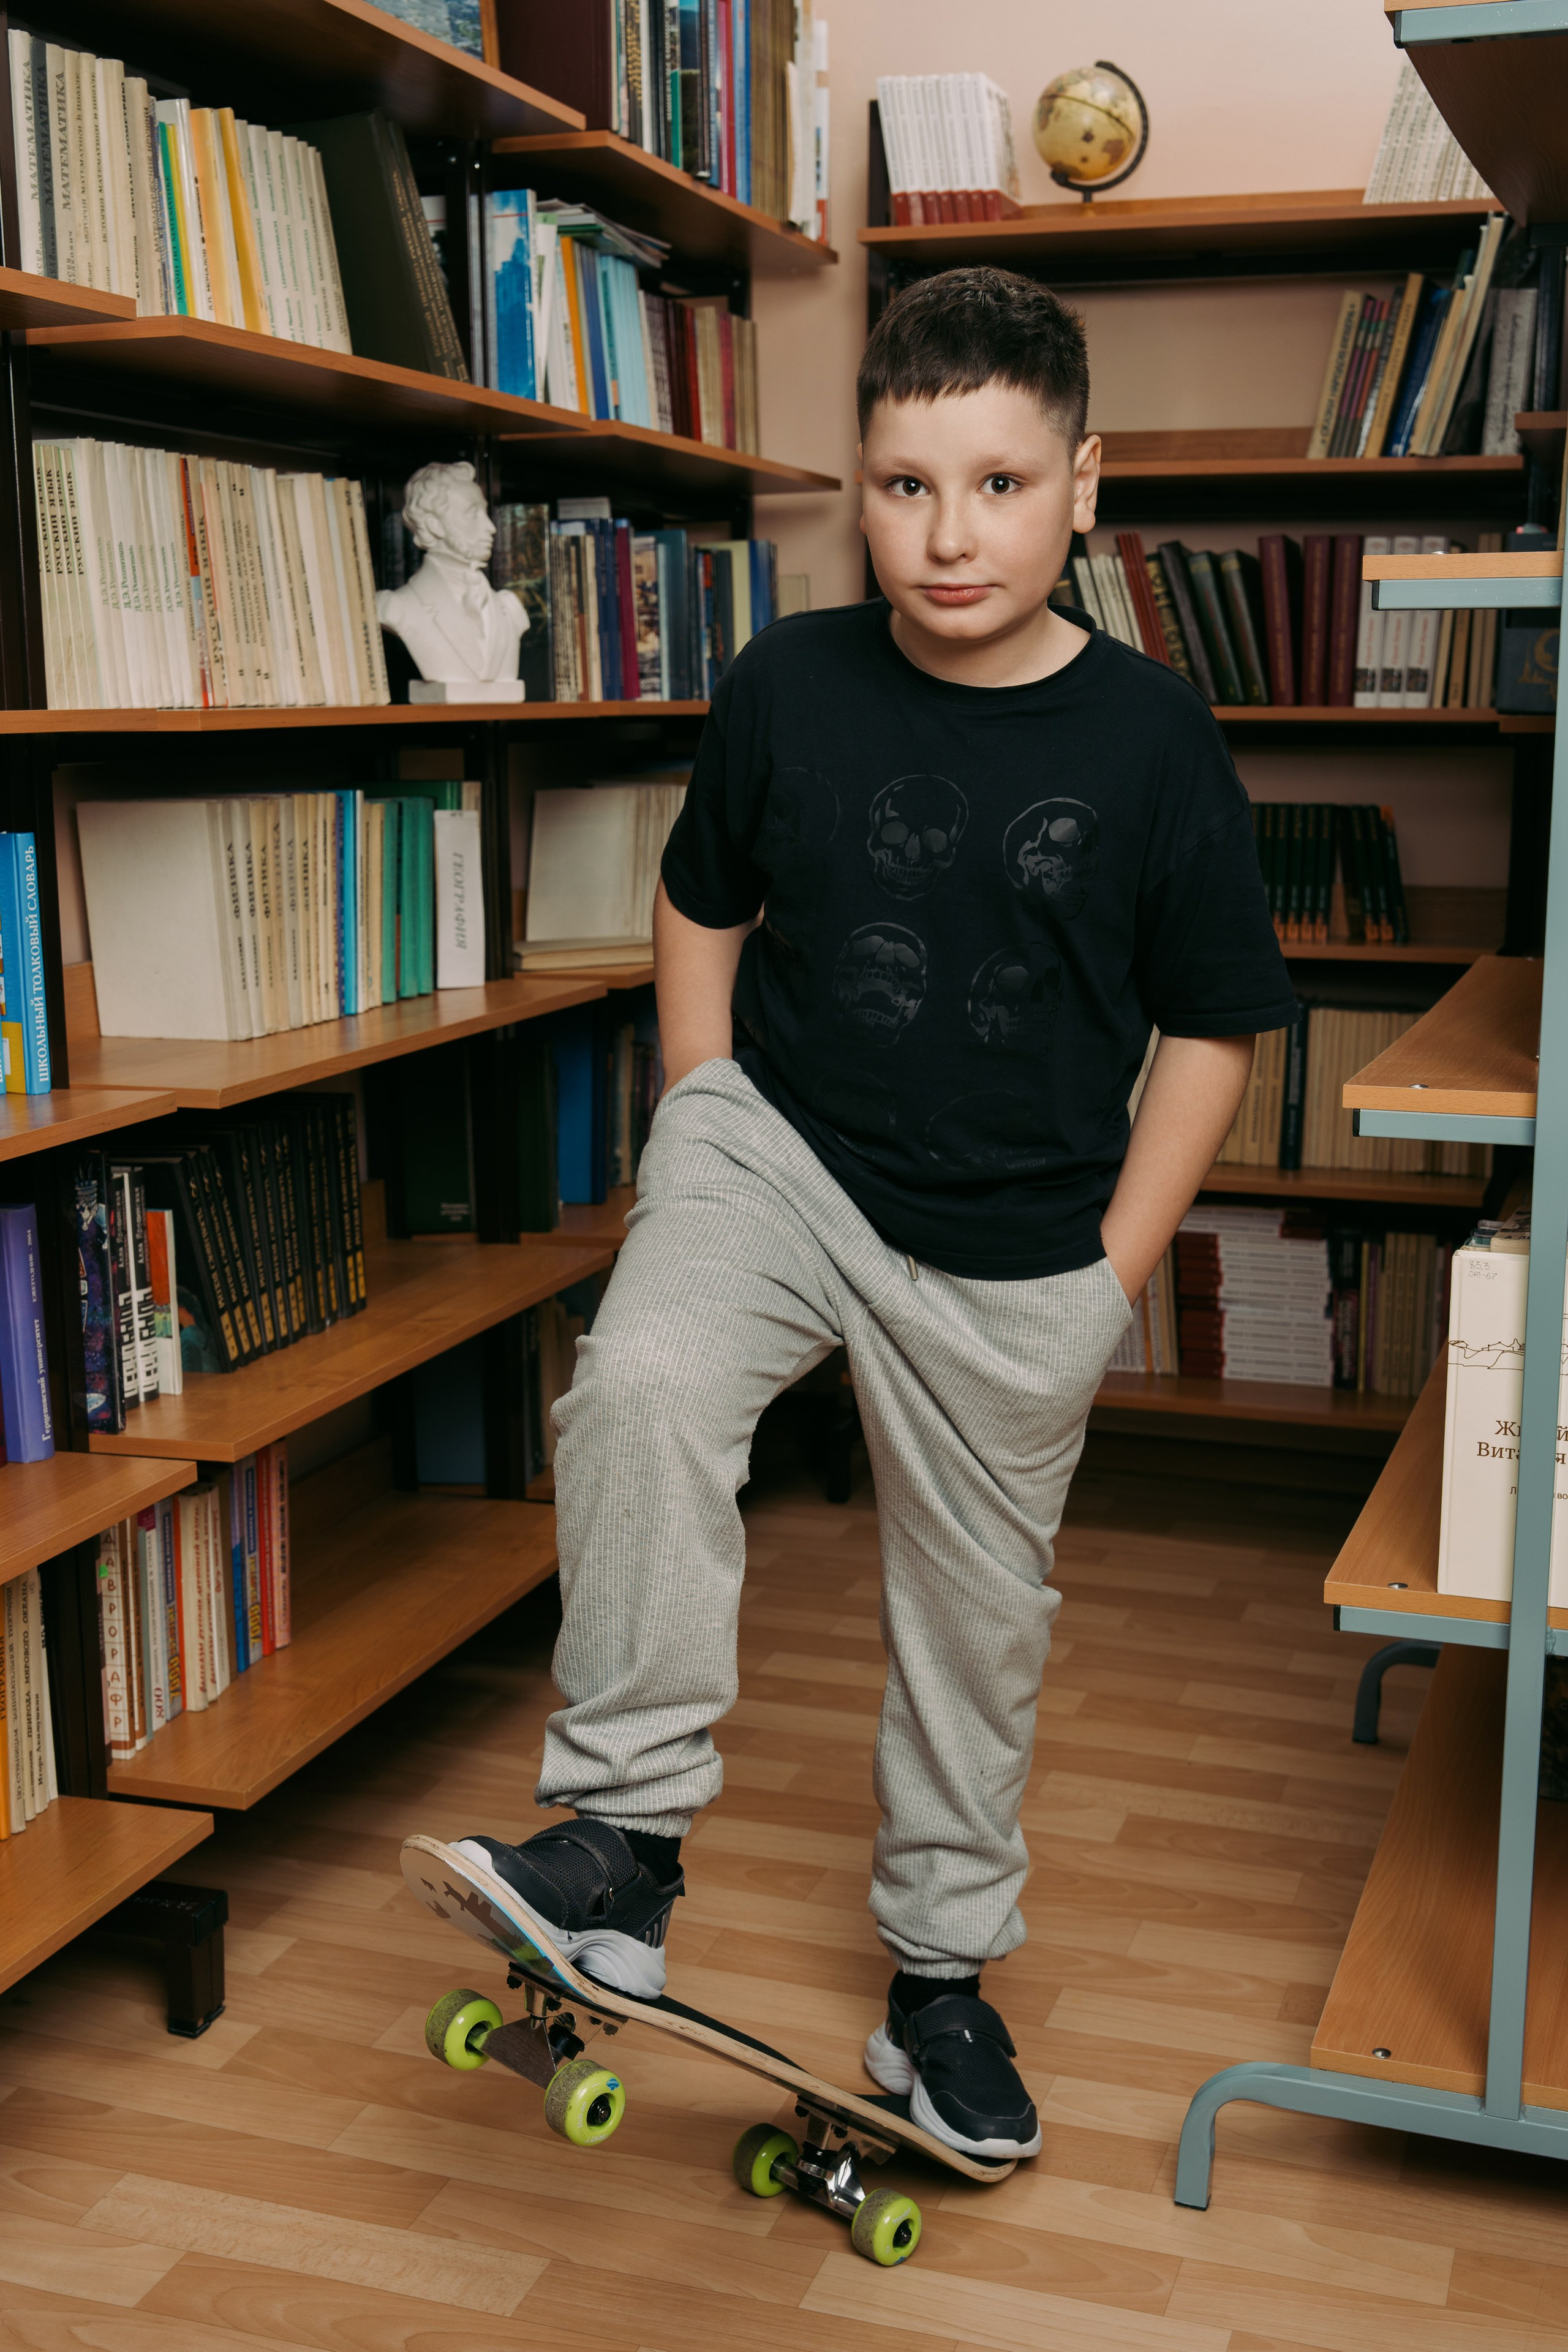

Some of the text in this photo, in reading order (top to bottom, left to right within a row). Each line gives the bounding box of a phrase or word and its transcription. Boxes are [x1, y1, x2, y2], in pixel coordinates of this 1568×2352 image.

[22, 61, 39, 200] МАТЕМАТИКА
[37, 64, 54, 205] МАТЕМАТИКА
[55, 72, 72, 210] МАТЕМАТИКА
[121, 82, 130, 156] ГЕОМЕТРИЮ
[77, 126, 86, 195] МАТЕМАТИКИ
[94, 125, 103, 194] МАТЕМАТИКИ
[36, 467, 51, 573] РУССКИЙ ЯЗЫК
[45, 469, 62, 574] РУССКИЙ ЯЗЫК
[61, 514, 72, 574] РУССКИЙ
[66, 471, 84, 575] РУССКИЙ ЯЗЫК
[198, 515, 219, 663] РУССКИЙ ЯЗЫК
[227, 842, 240, 918] ФИЗИКА
[245, 842, 255, 916] ФИЗИКА
[260, 844, 270, 918] ФИЗИКА
[287, 838, 296, 911] ФИЗИКА
[452, 851, 468, 950] ГЕОГРАФИЯ
[24, 845, 49, 1082] ШКОЛЬНЫЙ ТОЛКОВЫЙ СЛОВАРЬ
[33, 1319, 45, 1374] университет
[37, 1377, 51, 1441] Герценовский
[249, 1604, 261, 1648] 7000
[8, 1643, 18, 1722] ЗАНИМАТЕЛЬНОЙ
[155, 1688, 164, 1718] 800
[168, 1655, 180, 1703] 7000
[17, 1785, 22, 1800] ПО
